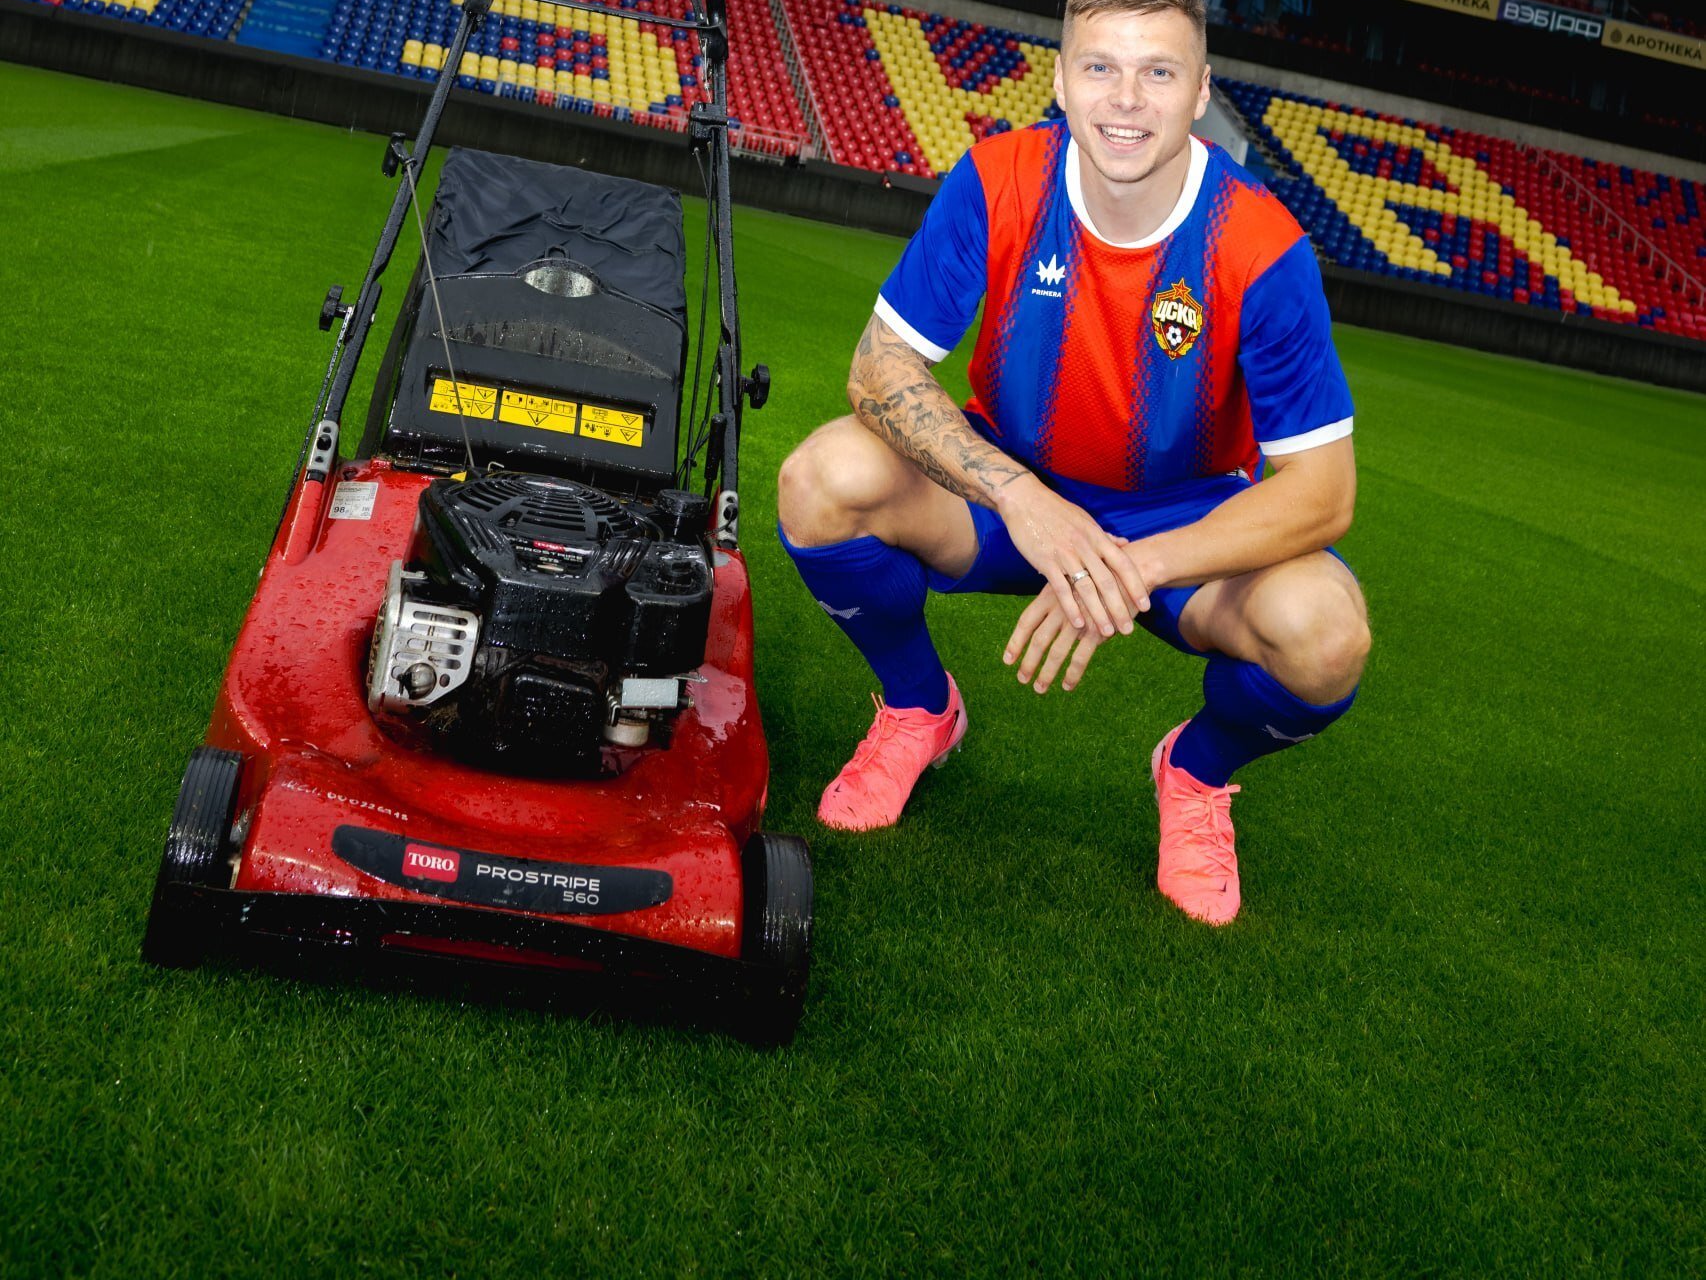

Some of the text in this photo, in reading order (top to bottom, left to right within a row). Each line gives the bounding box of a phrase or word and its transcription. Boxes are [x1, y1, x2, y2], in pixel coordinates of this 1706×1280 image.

[1625, 33, 1703, 62] APOTHEKA
[1031, 288, 1062, 298] PRIMERA
[1154, 300, 1198, 331] ЦСКА
[408, 852, 600, 892] TORO PROSTRIPE
[562, 890, 599, 905] 560
